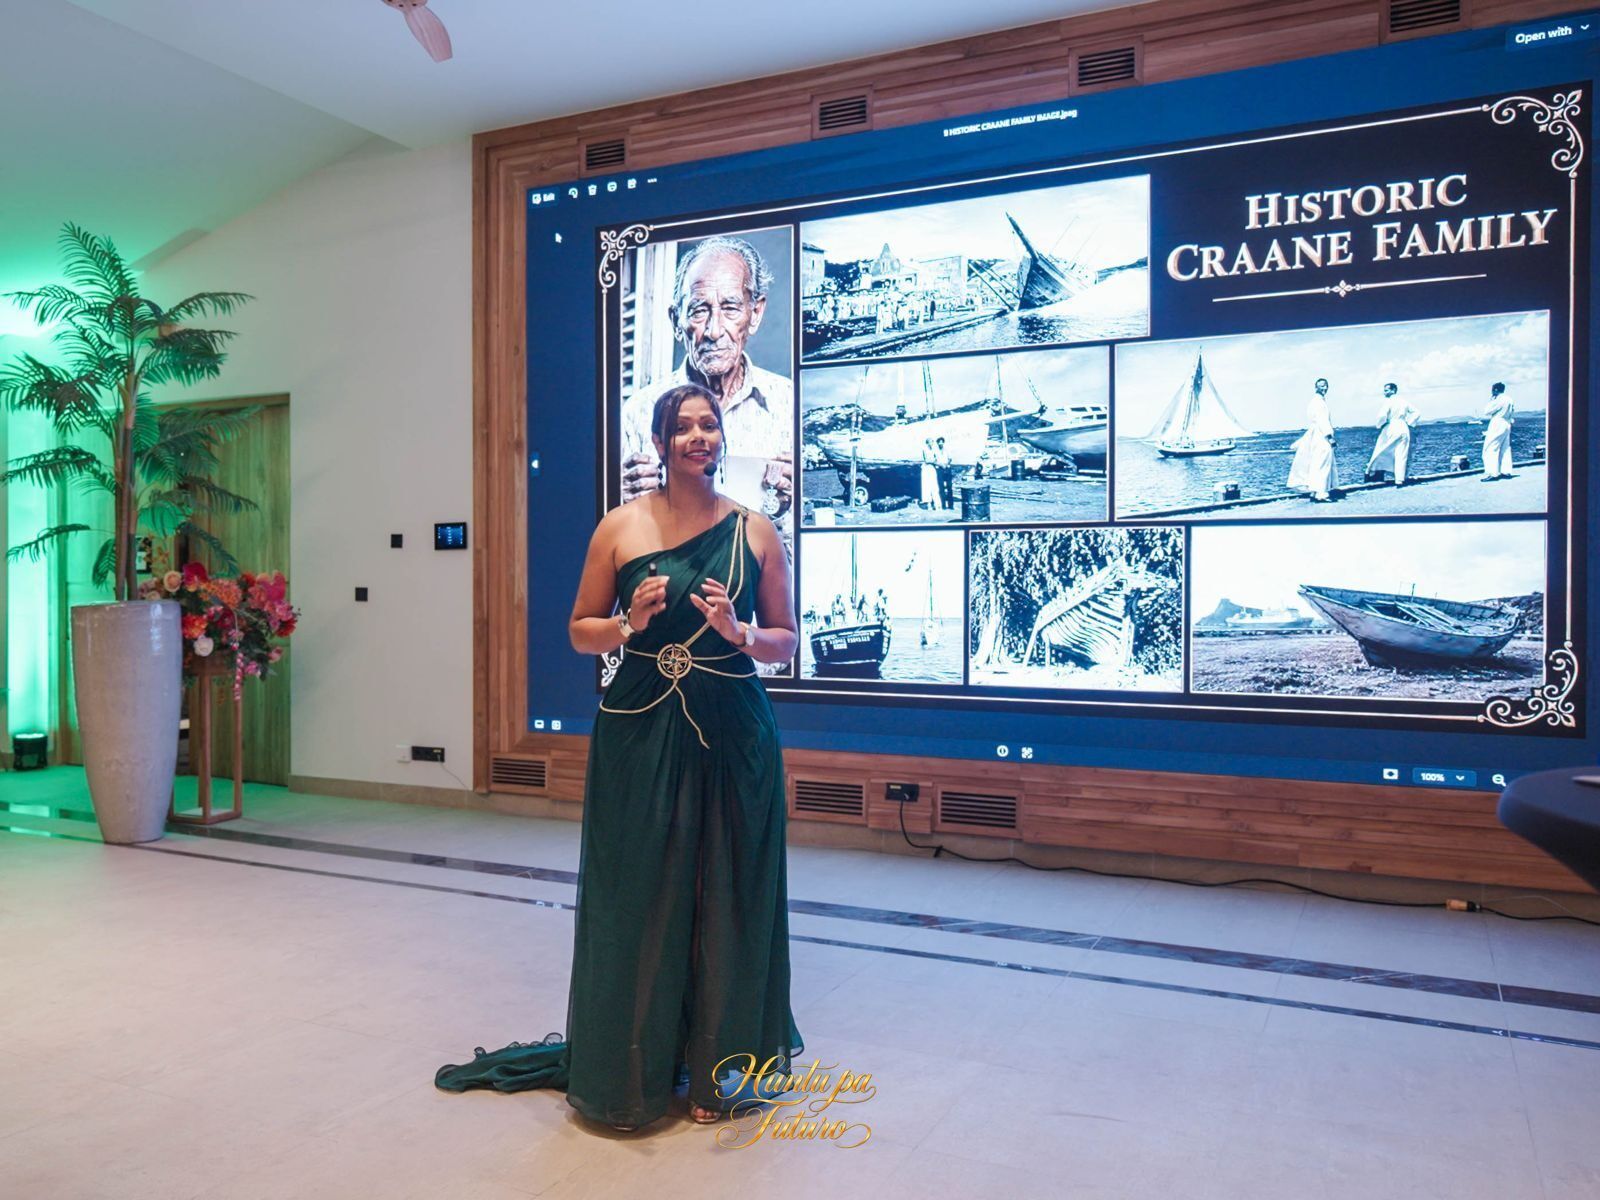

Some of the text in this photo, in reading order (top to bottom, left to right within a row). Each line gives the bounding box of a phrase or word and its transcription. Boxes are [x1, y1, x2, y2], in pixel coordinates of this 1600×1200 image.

[1515, 26, 1572, 44] Open with
[949, 124, 981, 136] HISTORIC
[981, 119, 1011, 131] CRAANE
[1010, 115, 1037, 127] FAMILY
[1245, 174, 1468, 230] HISTORIC
[1166, 208, 1558, 282] CRAANE FAMILY
[1421, 773, 1445, 782] 100%
